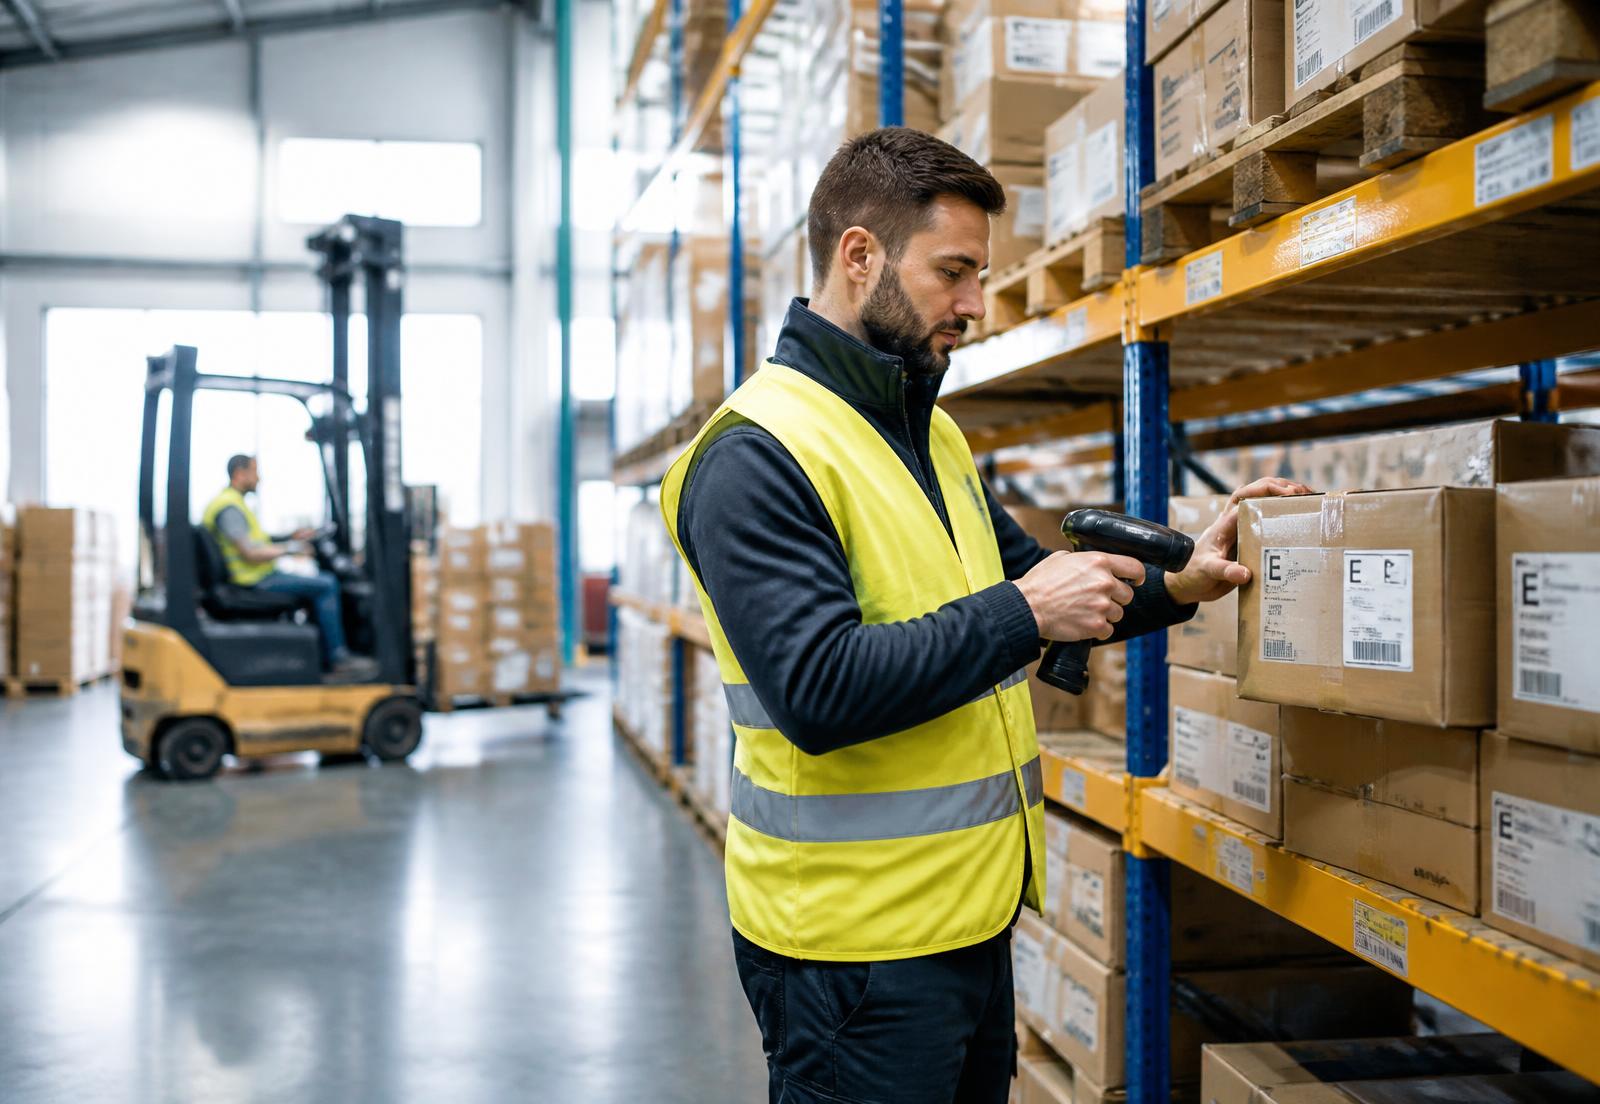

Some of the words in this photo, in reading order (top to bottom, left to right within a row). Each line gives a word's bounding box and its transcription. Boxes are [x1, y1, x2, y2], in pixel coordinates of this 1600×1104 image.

[1269, 555, 1282, 581] E
[1350, 559, 1362, 583] E
[1522, 572, 1539, 606] E
[1499, 811, 1513, 840] E
